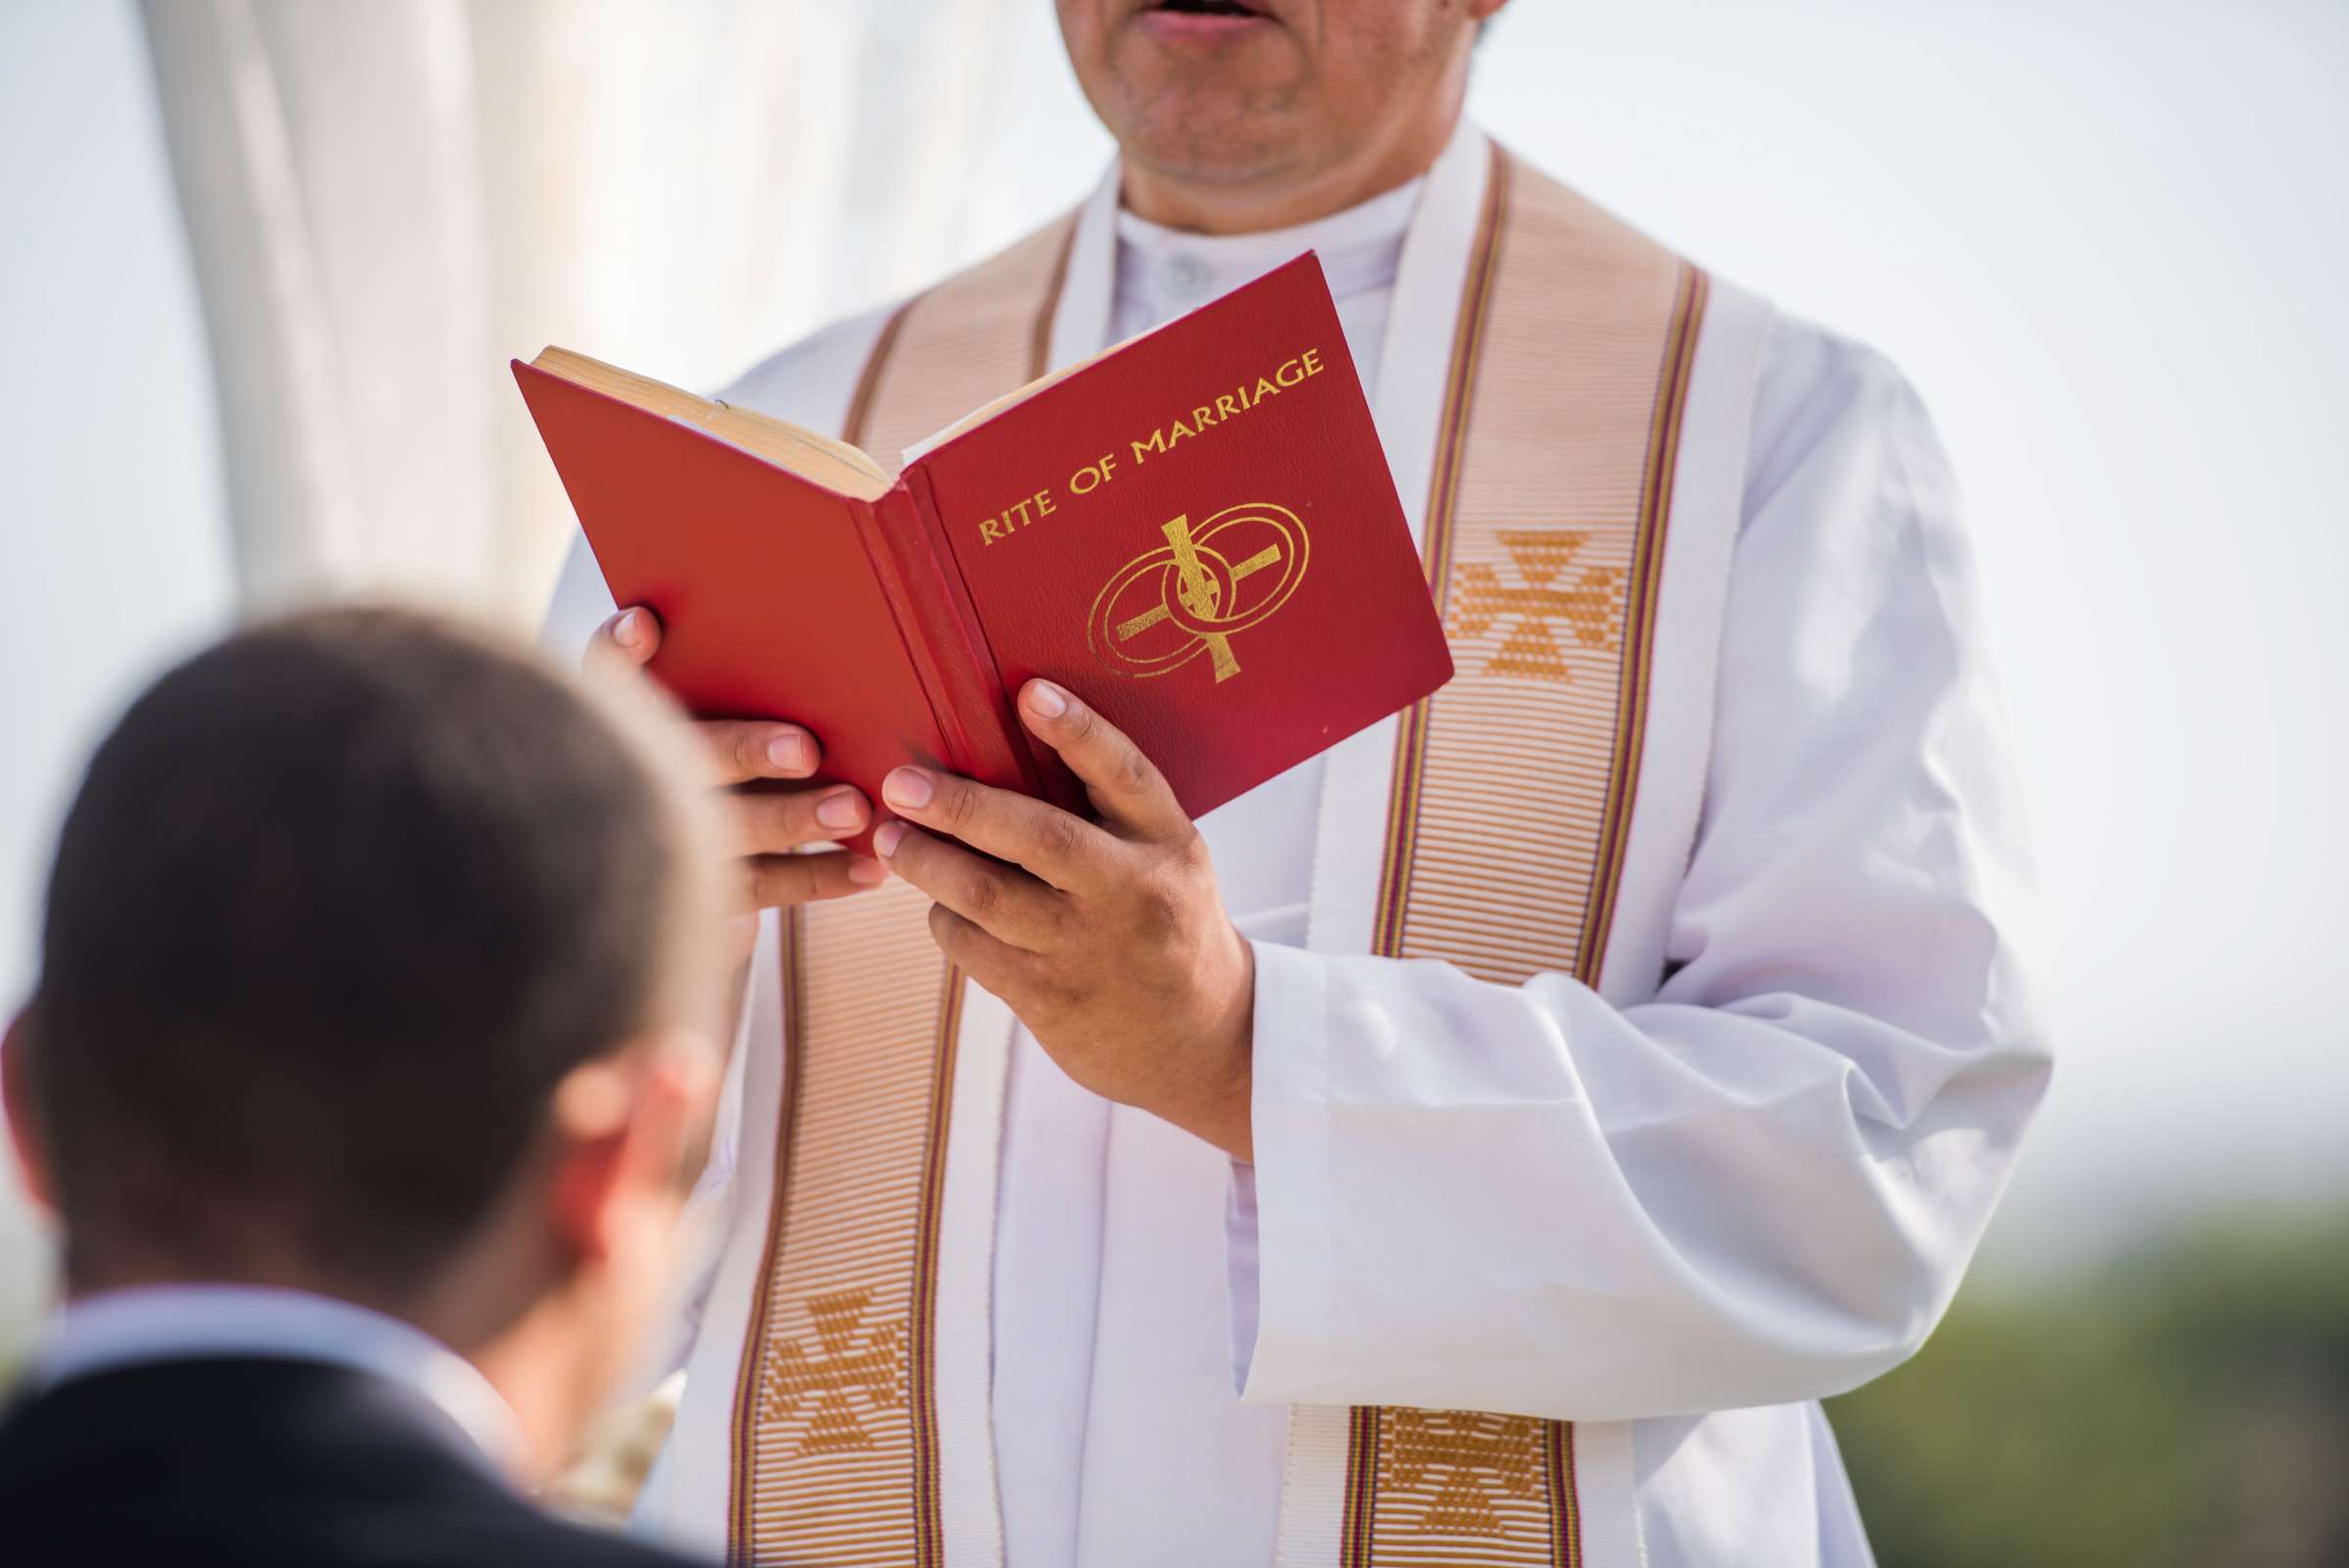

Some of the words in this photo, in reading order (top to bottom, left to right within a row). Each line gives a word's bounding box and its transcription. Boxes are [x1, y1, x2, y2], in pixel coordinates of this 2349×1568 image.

[978, 488, 1056, 546] RITE
[1069, 453, 1118, 495] OF
[1130, 347, 1324, 465] MARRIAGE
